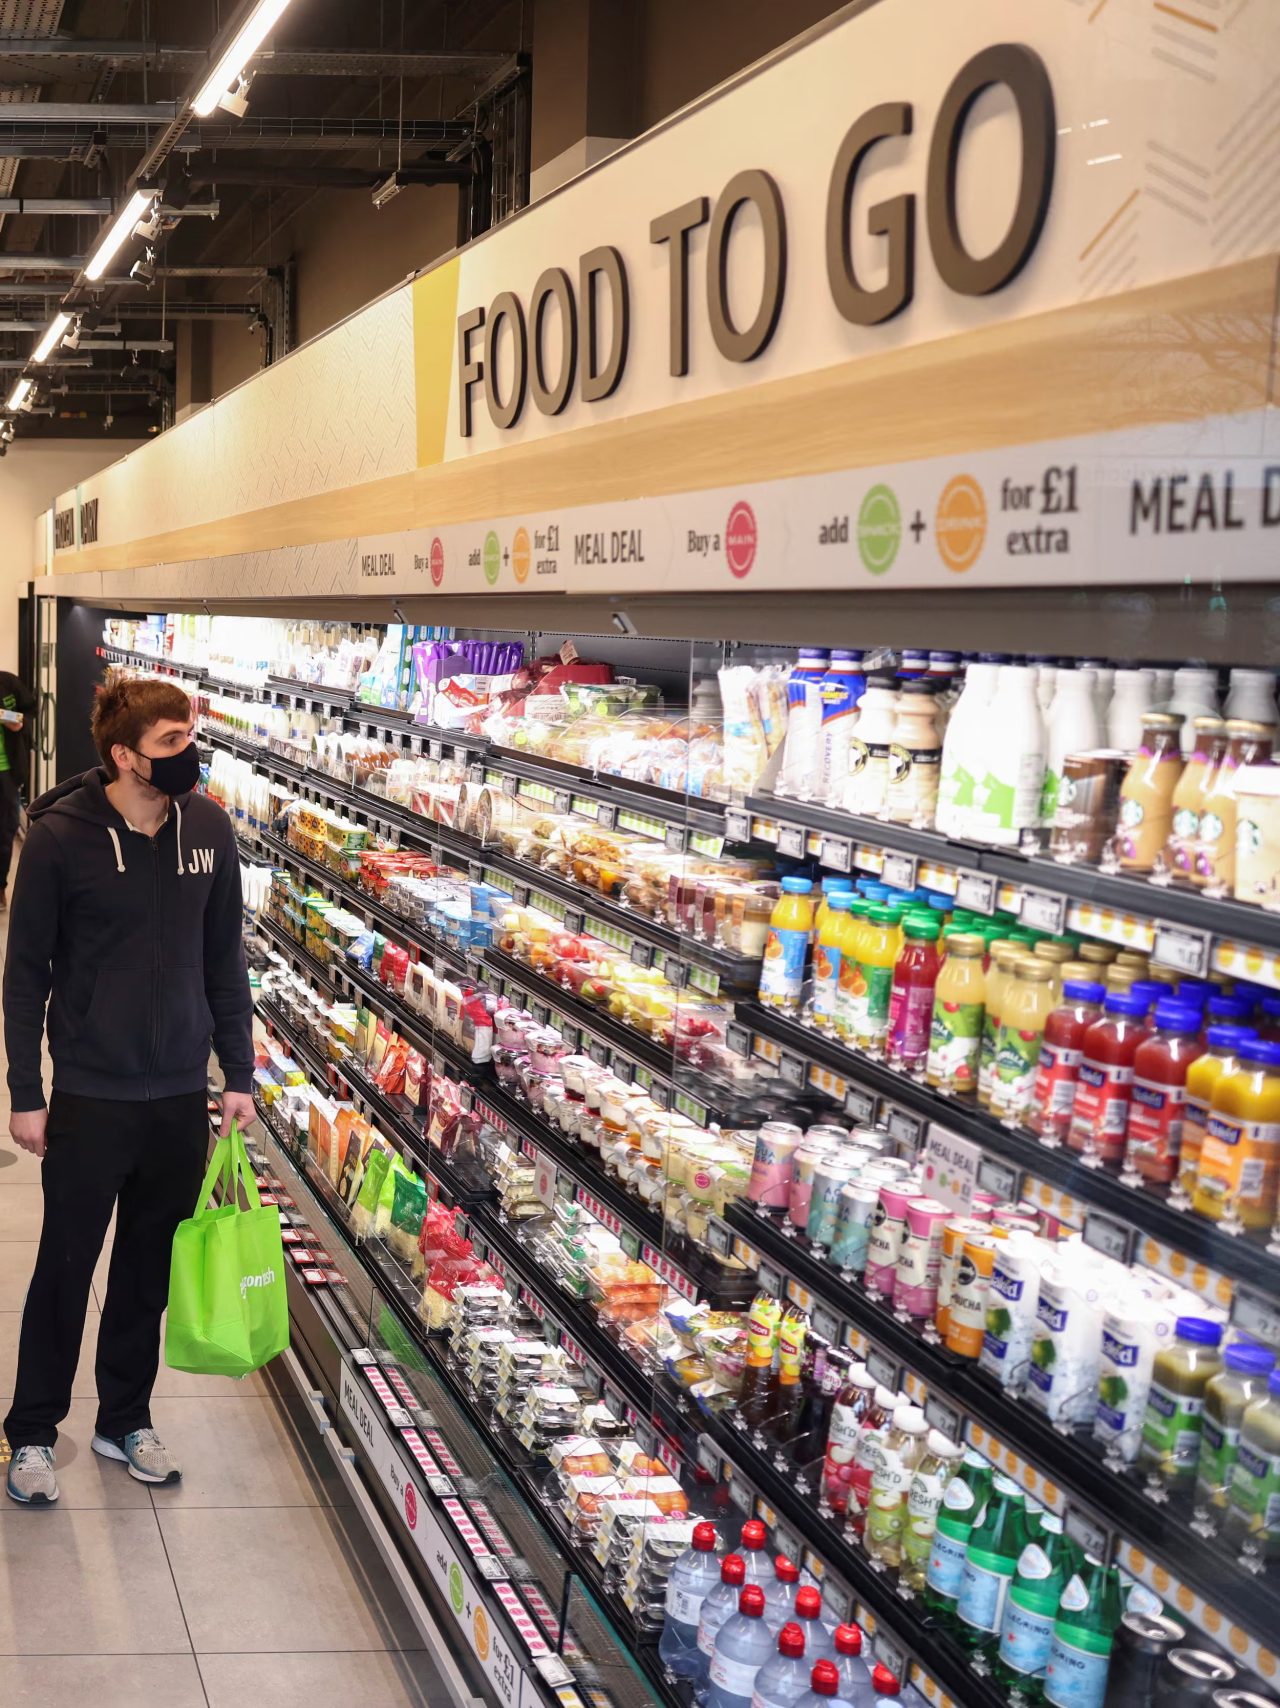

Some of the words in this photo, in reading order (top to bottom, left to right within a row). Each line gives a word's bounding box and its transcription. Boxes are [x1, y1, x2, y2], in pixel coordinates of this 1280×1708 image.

[456, 245, 629, 438] FOOD
[649, 168, 788, 378] TO
[825, 42, 1059, 327] GO
[1001, 477, 1036, 512] for
[1040, 465, 1080, 516] £1
[1129, 469, 1245, 536] MEAL
[534, 530, 546, 550] for
[546, 525, 559, 552] £1
[687, 528, 710, 559] Buy
[710, 536, 721, 552] a
[818, 516, 850, 545] add
[1005, 525, 1070, 556] extra
[414, 553, 425, 572] Buy
[468, 548, 481, 567] add
[573, 531, 609, 566] MEAL
[610, 529, 645, 564] DEAL
[361, 554, 379, 578] MEAL
[379, 552, 396, 576] DEAL
[536, 558, 557, 575] extra
[188, 848, 215, 875] JW
[930, 1139, 951, 1162] MEAL
[952, 1151, 974, 1175] DEAL
[343, 1379, 360, 1422] MEAL
[359, 1405, 375, 1448] DEAL
